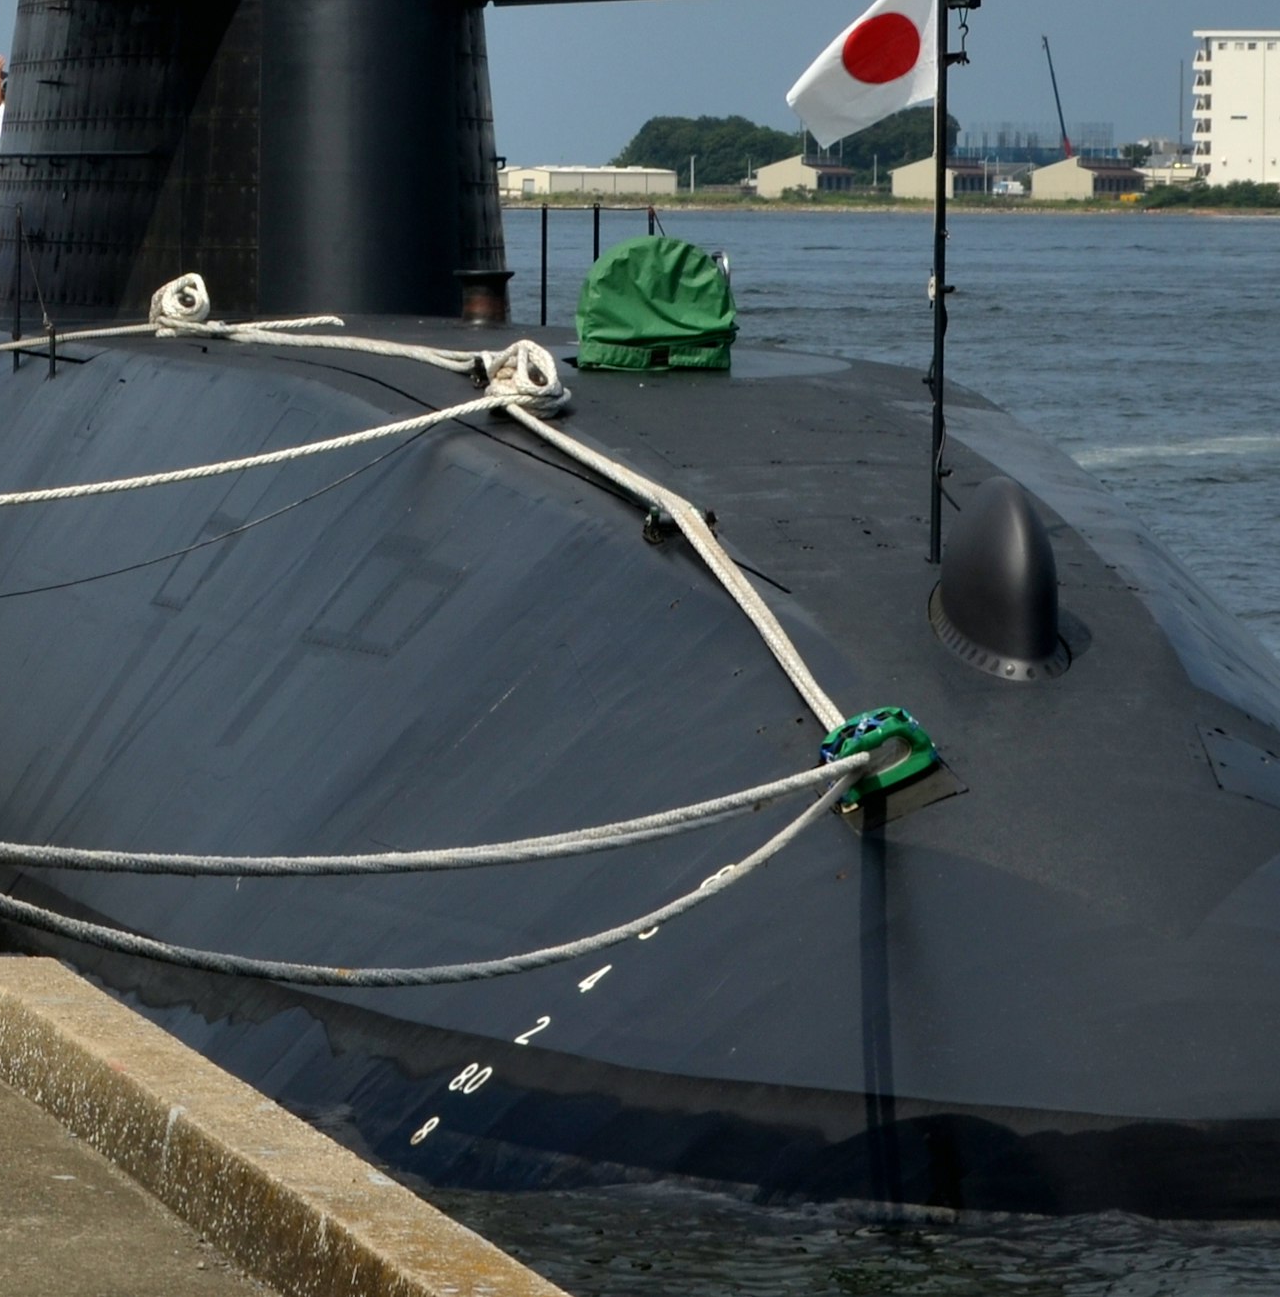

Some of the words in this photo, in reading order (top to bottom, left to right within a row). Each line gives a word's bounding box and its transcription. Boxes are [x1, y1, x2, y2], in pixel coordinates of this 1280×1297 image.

[578, 964, 612, 993] 4
[514, 1015, 551, 1045] 2
[410, 1116, 440, 1145] 8
